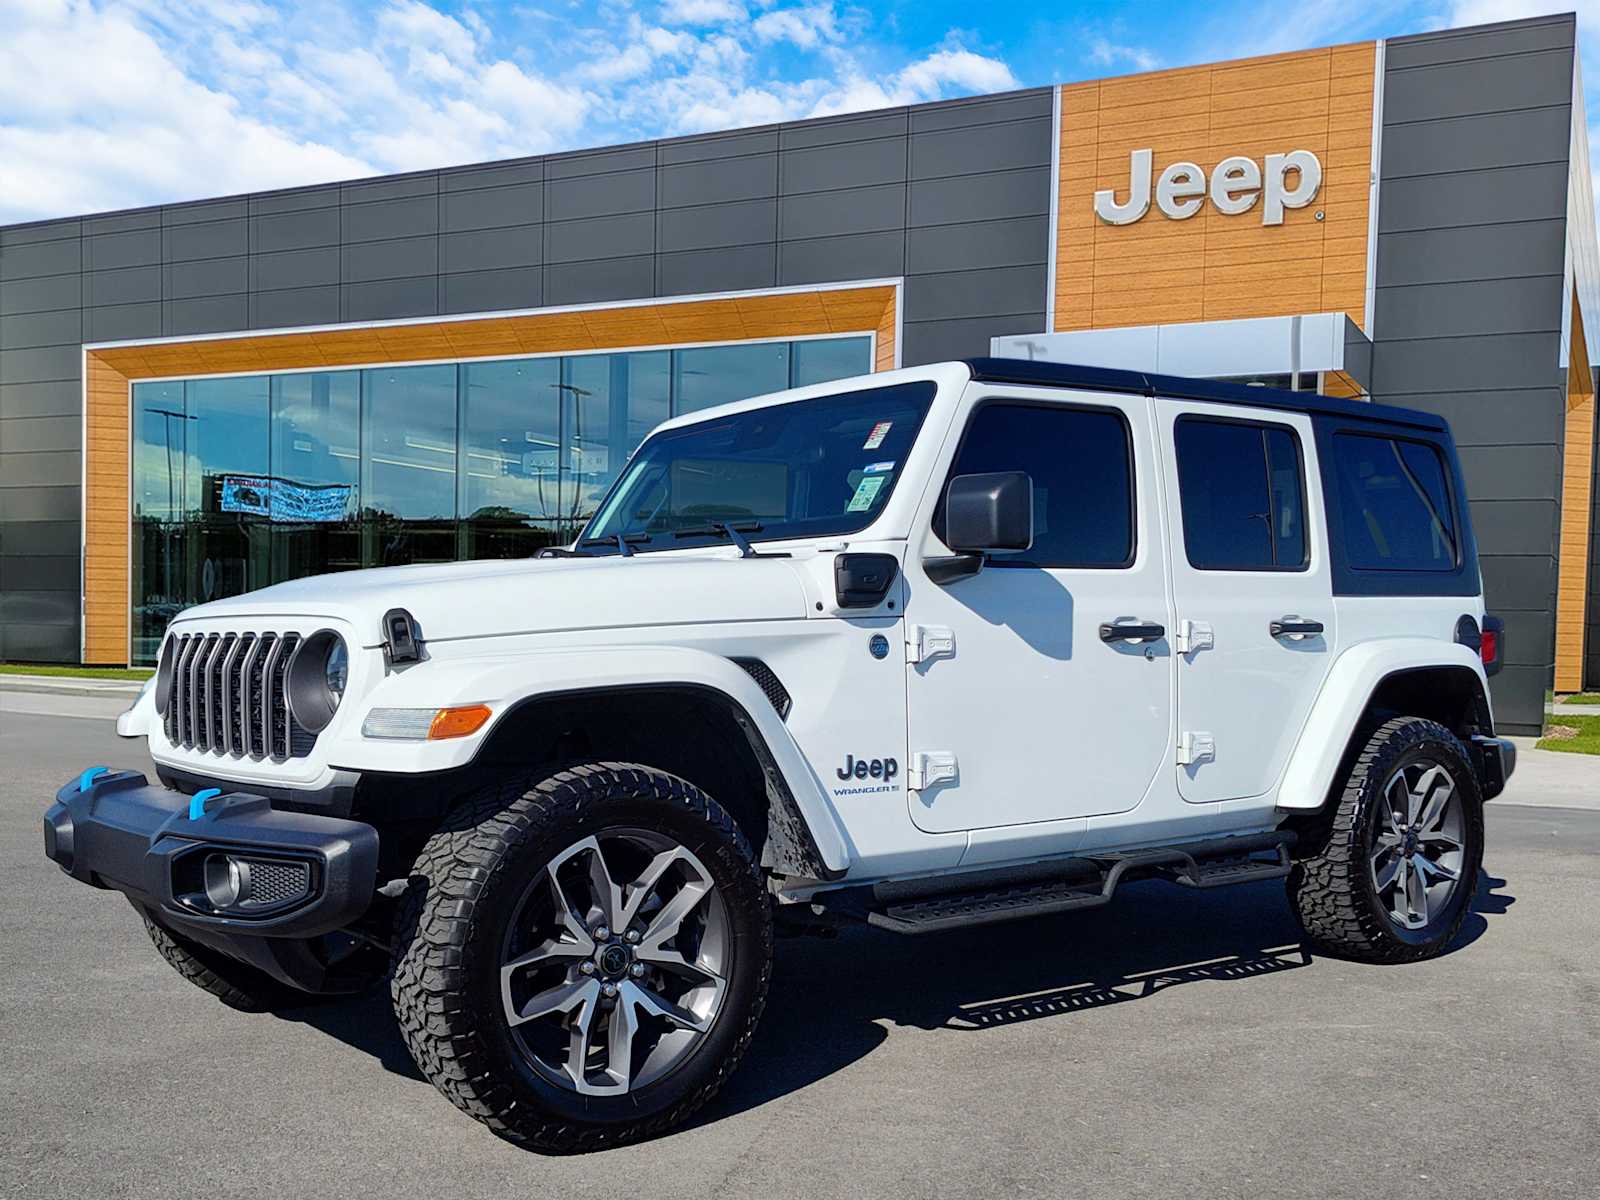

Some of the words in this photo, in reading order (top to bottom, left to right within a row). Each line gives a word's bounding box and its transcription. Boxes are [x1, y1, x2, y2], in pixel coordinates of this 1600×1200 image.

[1094, 148, 1322, 226] Jeep
[836, 754, 898, 782] Jeep
[834, 786, 890, 796] WRANGLER
